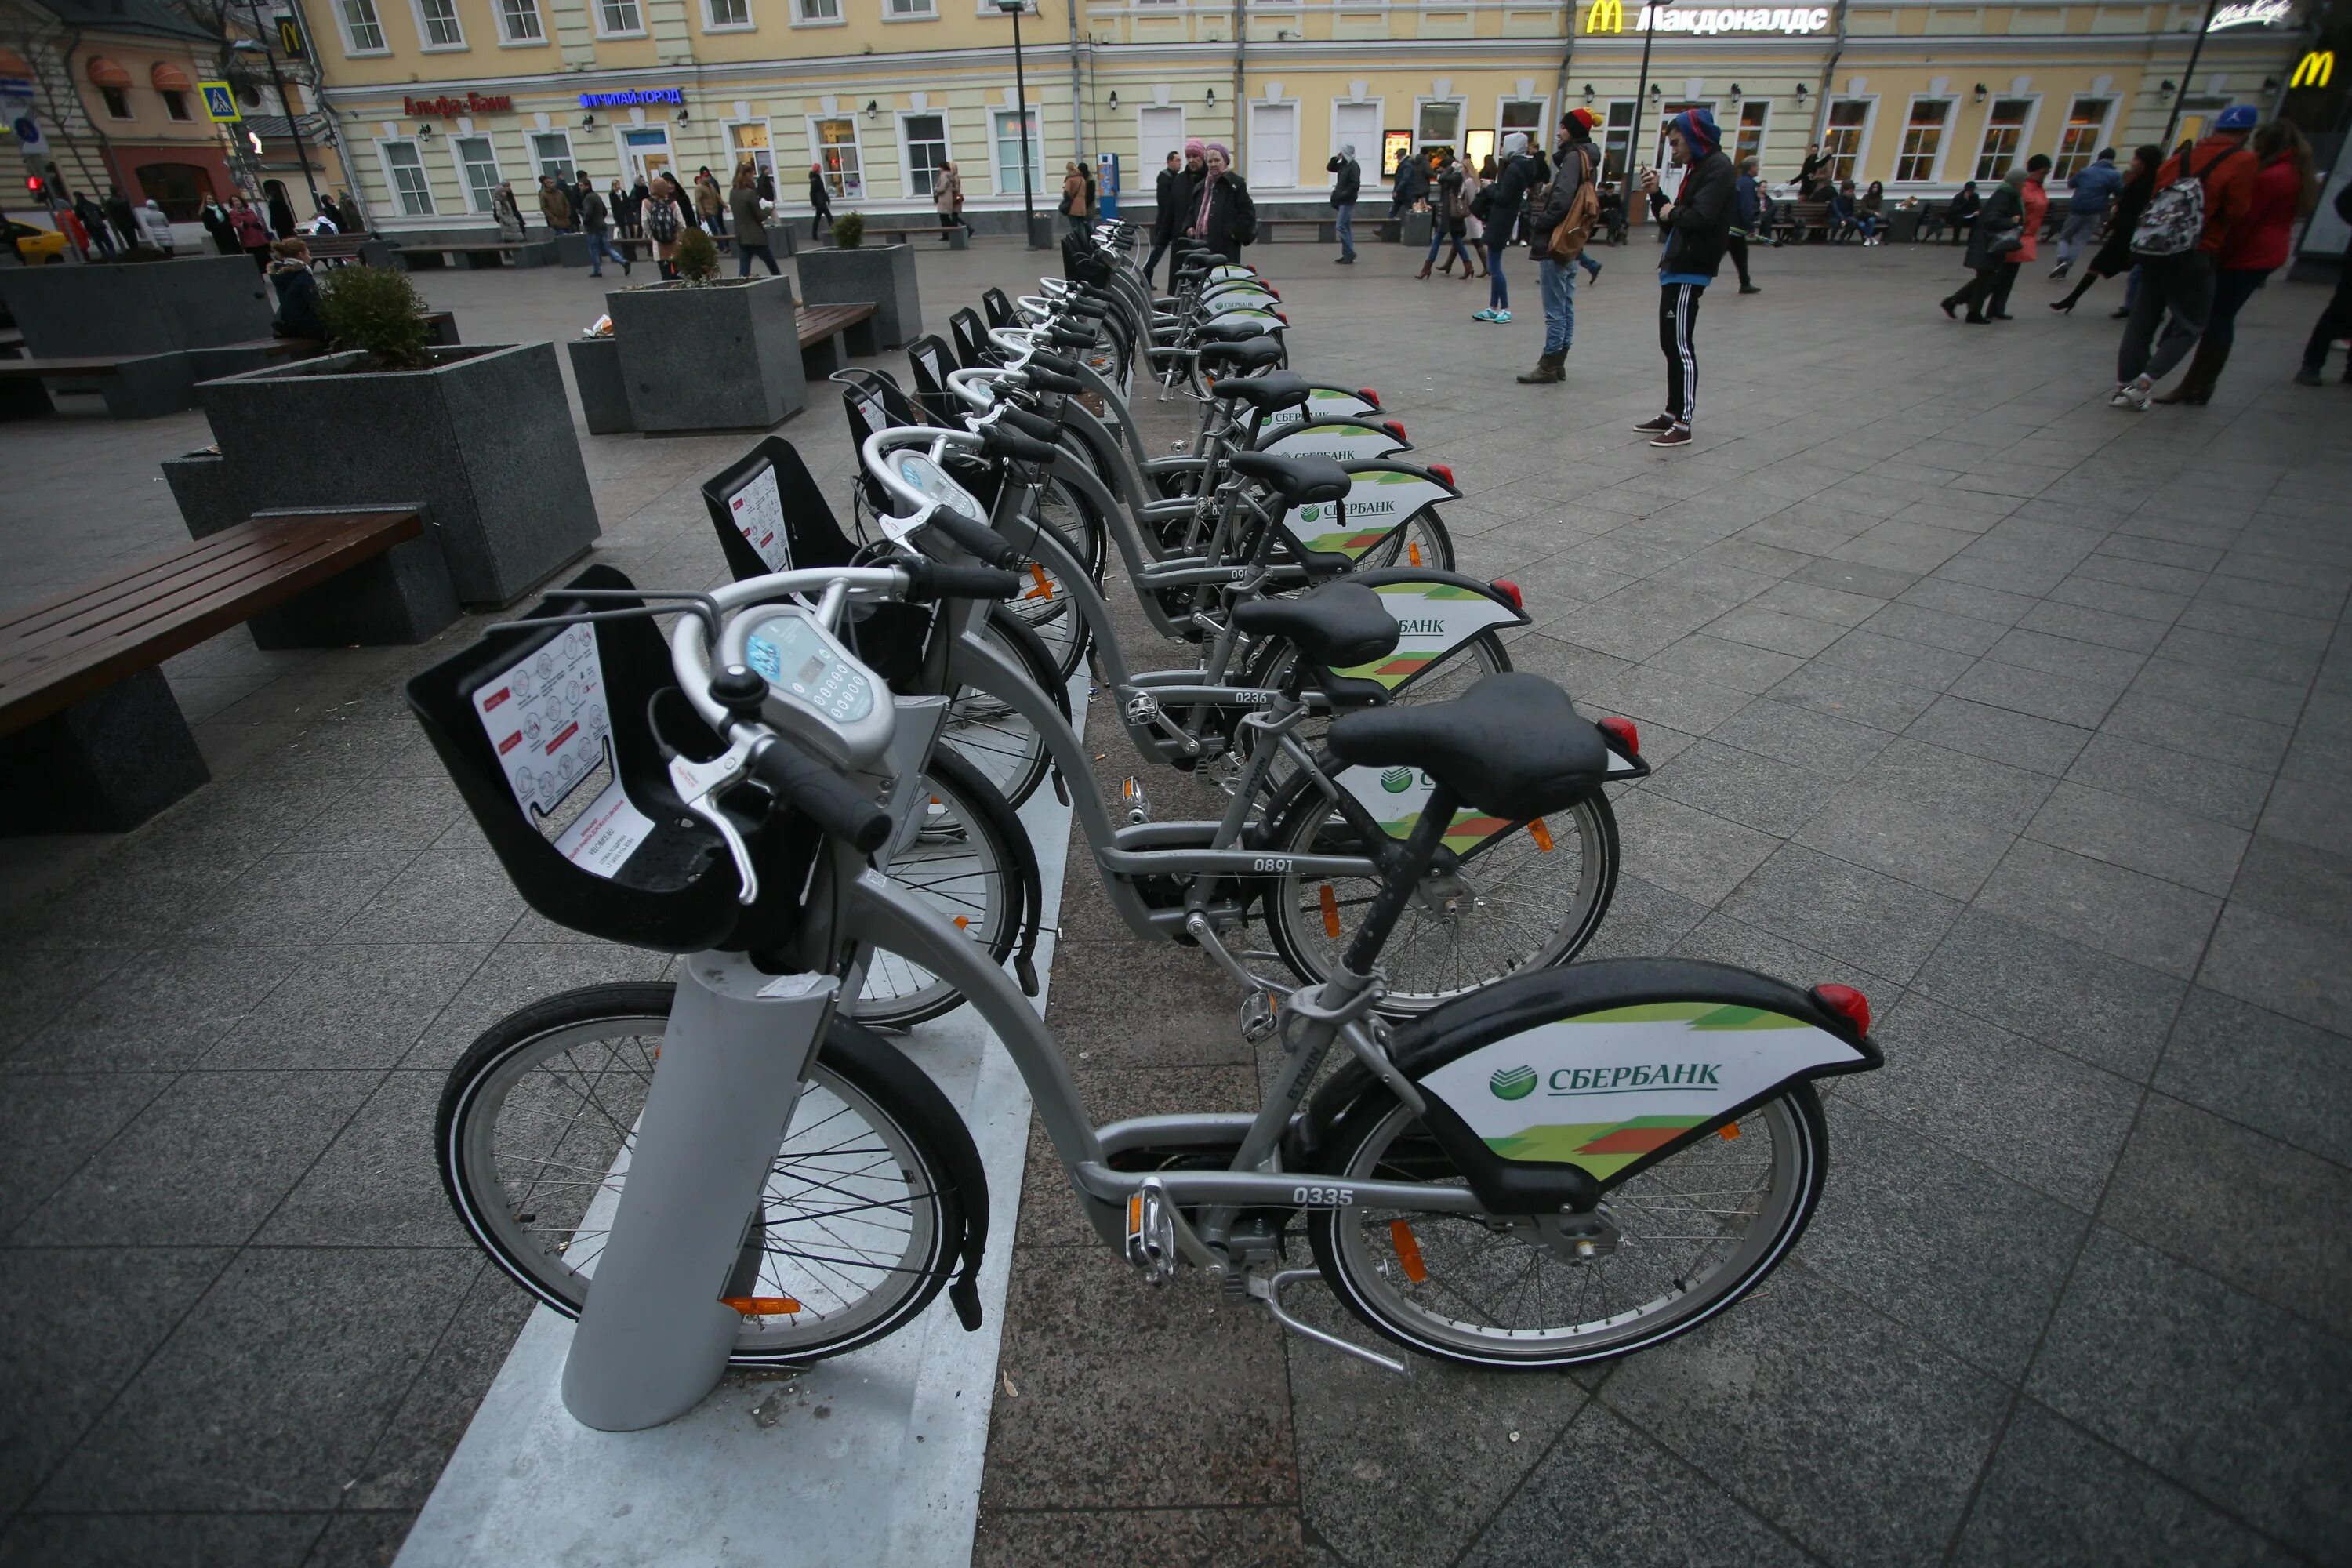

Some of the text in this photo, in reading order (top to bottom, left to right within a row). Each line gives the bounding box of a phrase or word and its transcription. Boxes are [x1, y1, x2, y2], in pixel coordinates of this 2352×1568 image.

[1635, 5, 1828, 34] Макдоналдс
[600, 88, 681, 107] ЧИТАЙ-ГОРОД
[1276, 412, 1330, 422] СБЕР
[1399, 619, 1445, 633] БАНК
[1236, 692, 1267, 703] 0236
[1254, 858, 1293, 872] 0891
[1548, 1064, 1722, 1090] СБЕРБАНК
[1293, 1187, 1353, 1205] 0335
